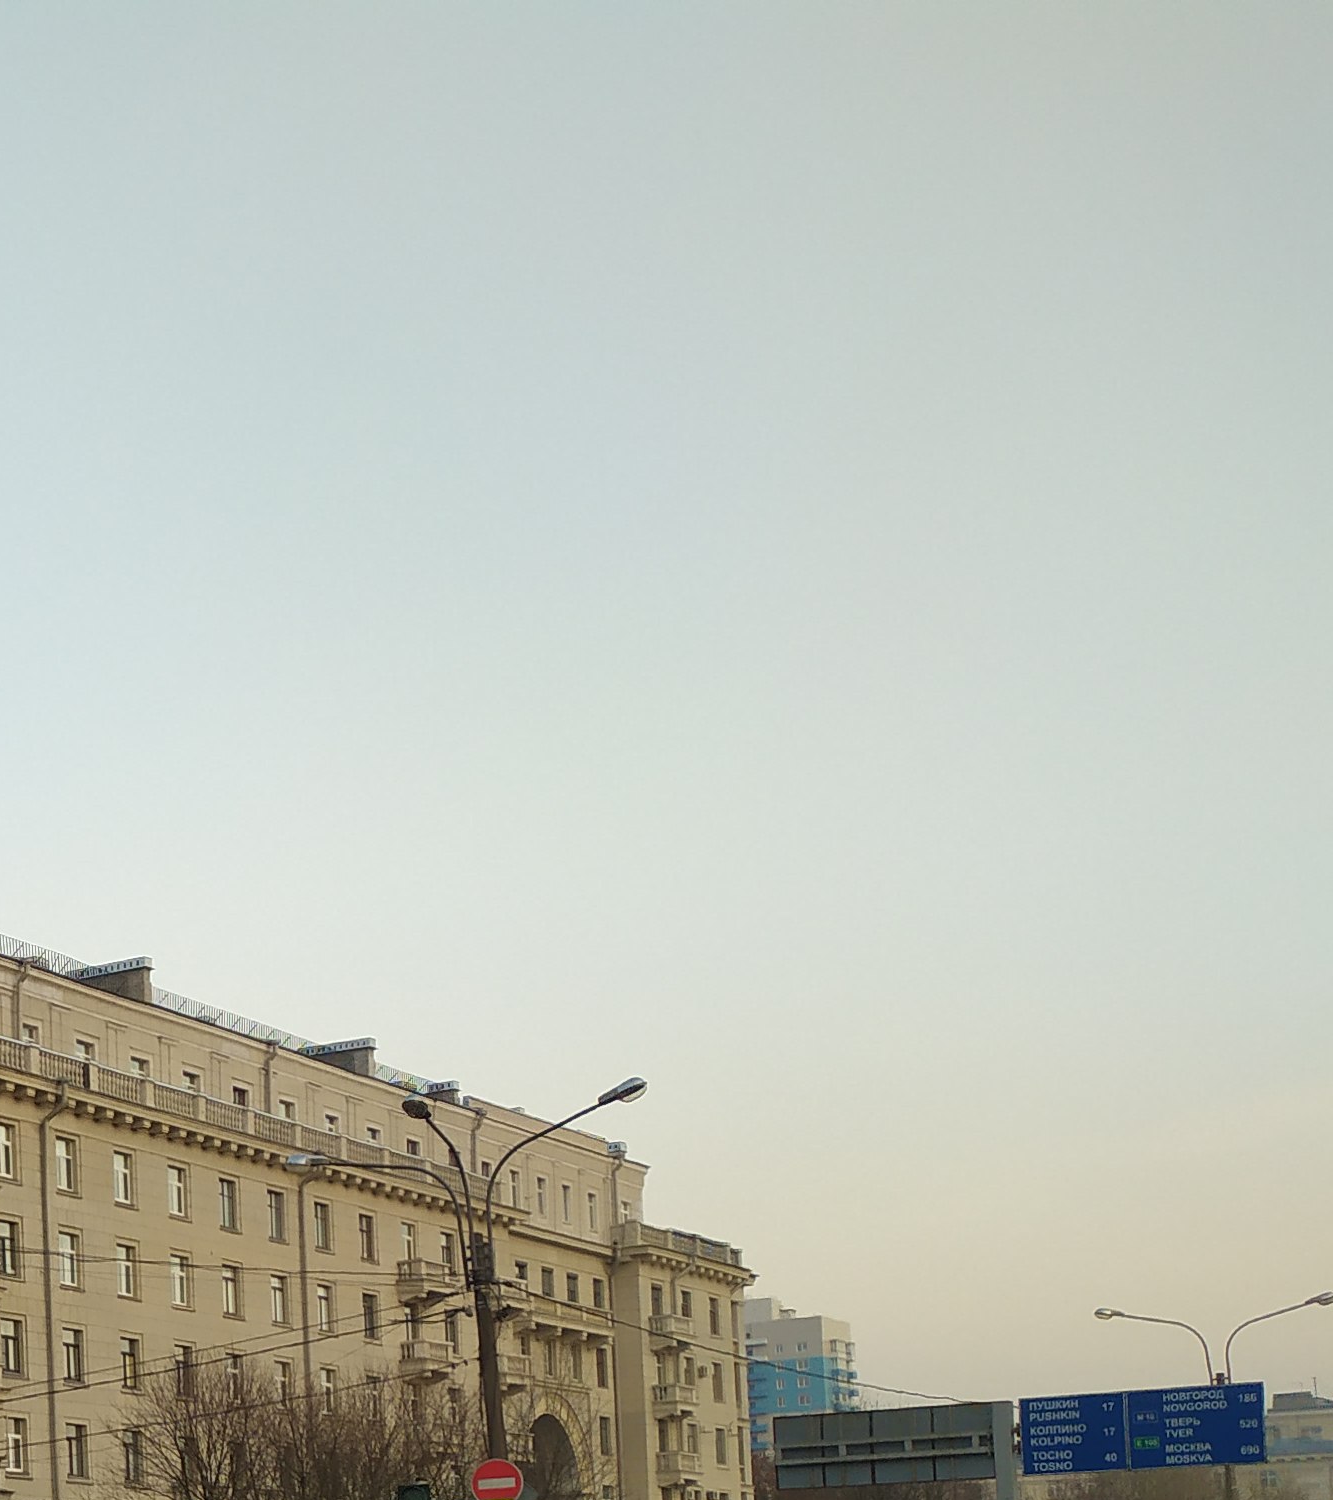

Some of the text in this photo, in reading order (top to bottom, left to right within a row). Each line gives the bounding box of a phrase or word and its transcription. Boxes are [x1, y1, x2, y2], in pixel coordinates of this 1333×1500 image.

[1162, 1390, 1224, 1402] НОВГОРОД
[1029, 1400, 1114, 1411] ПУШКИН 17
[1163, 1401, 1227, 1412] NOVGOROD
[1030, 1410, 1080, 1421] PUSHKIN
[1164, 1418, 1258, 1428] ТВЕРЬ 520
[1030, 1424, 1115, 1436] КОЛПИНО 17
[1165, 1429, 1193, 1438] TVER
[1030, 1436, 1082, 1446] KOLPINO
[1165, 1442, 1259, 1454] МОСКВА 690
[1033, 1451, 1117, 1462] ТОСНО 40
[1166, 1454, 1212, 1464] MOSKVA
[1033, 1461, 1073, 1471] TOSNO
